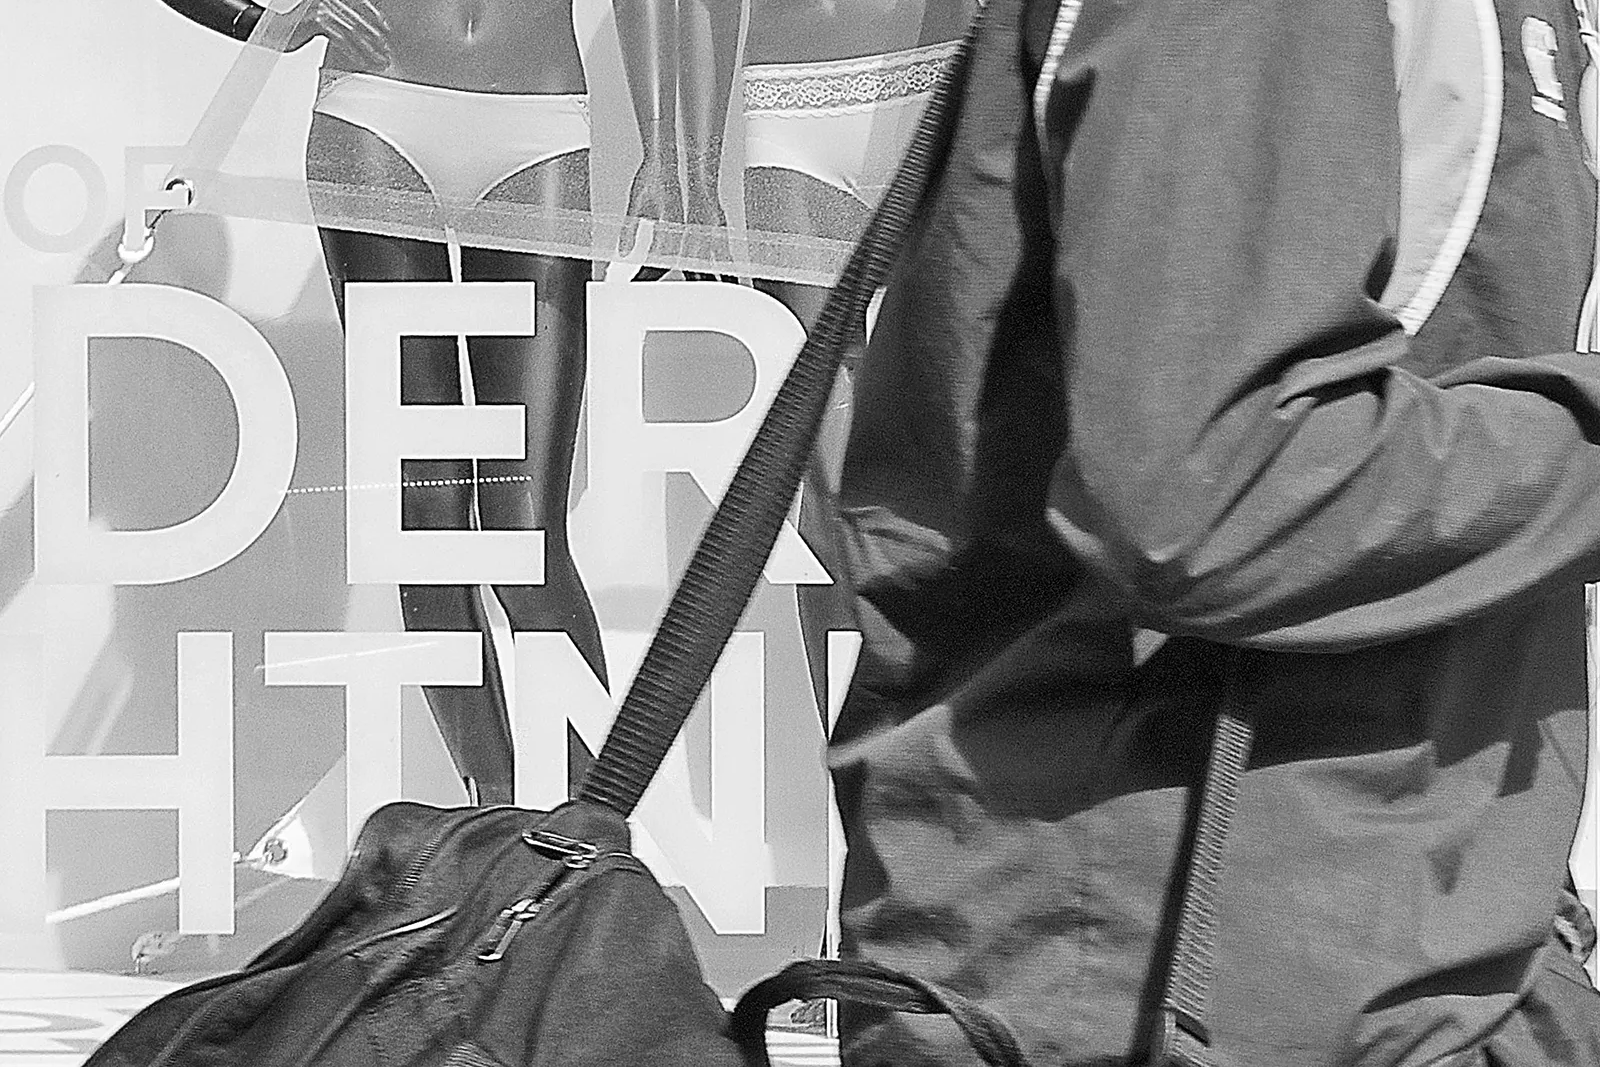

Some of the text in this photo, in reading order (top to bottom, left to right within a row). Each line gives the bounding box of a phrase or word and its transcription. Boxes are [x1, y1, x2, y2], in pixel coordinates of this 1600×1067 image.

[3, 144, 190, 253] OF
[34, 280, 834, 585] DER
[0, 631, 863, 934] HTN
